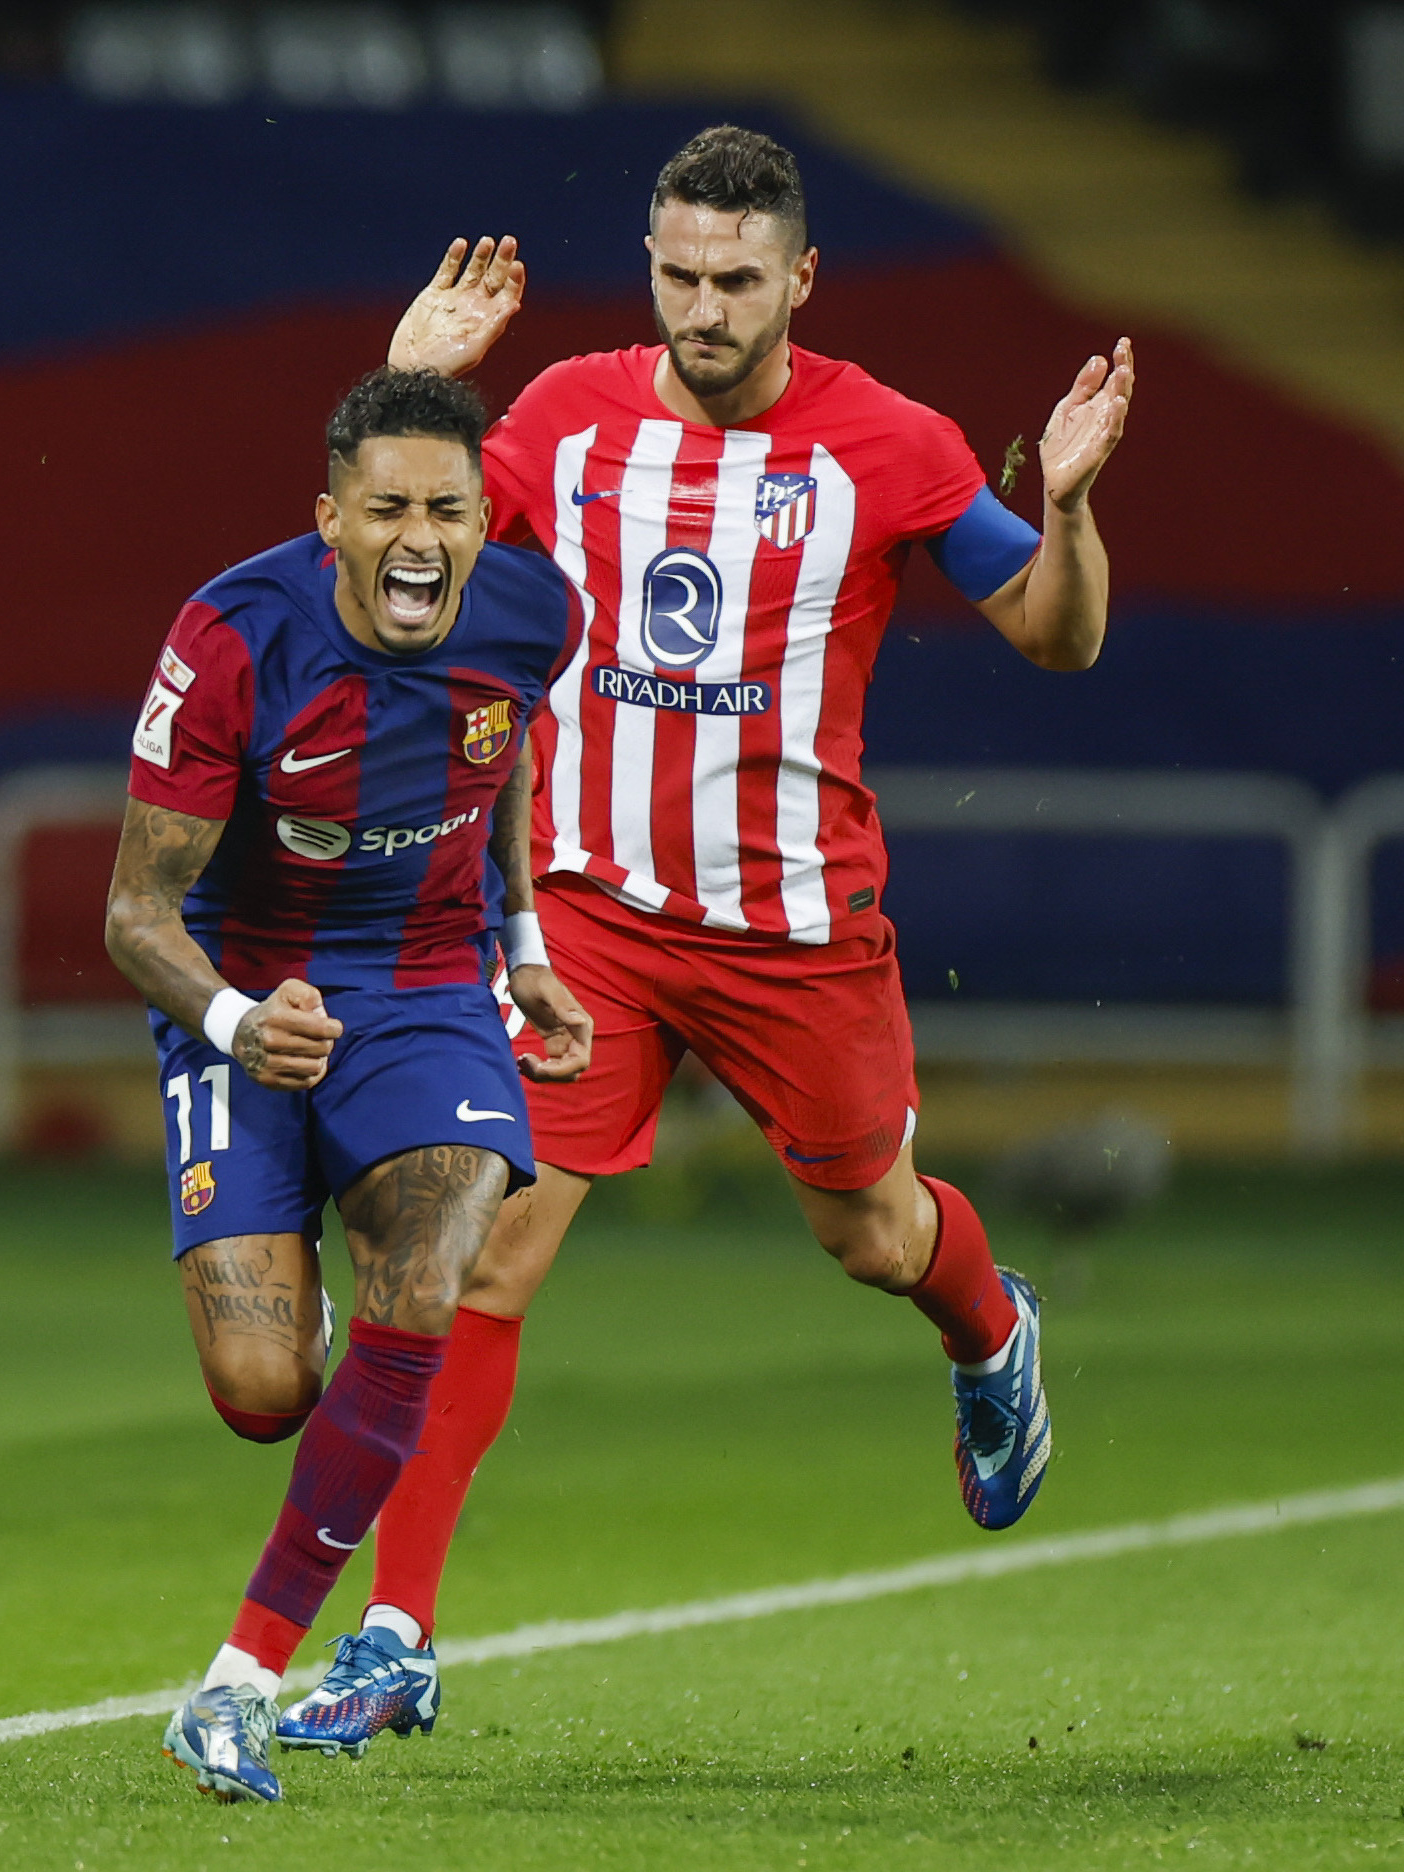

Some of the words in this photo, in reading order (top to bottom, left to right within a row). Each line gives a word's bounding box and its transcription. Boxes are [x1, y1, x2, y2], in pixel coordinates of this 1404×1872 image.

[598, 668, 702, 710] RIYADH
[711, 685, 765, 712] AIR
[136, 731, 164, 756] ALIGA
[165, 1063, 231, 1165] 11
